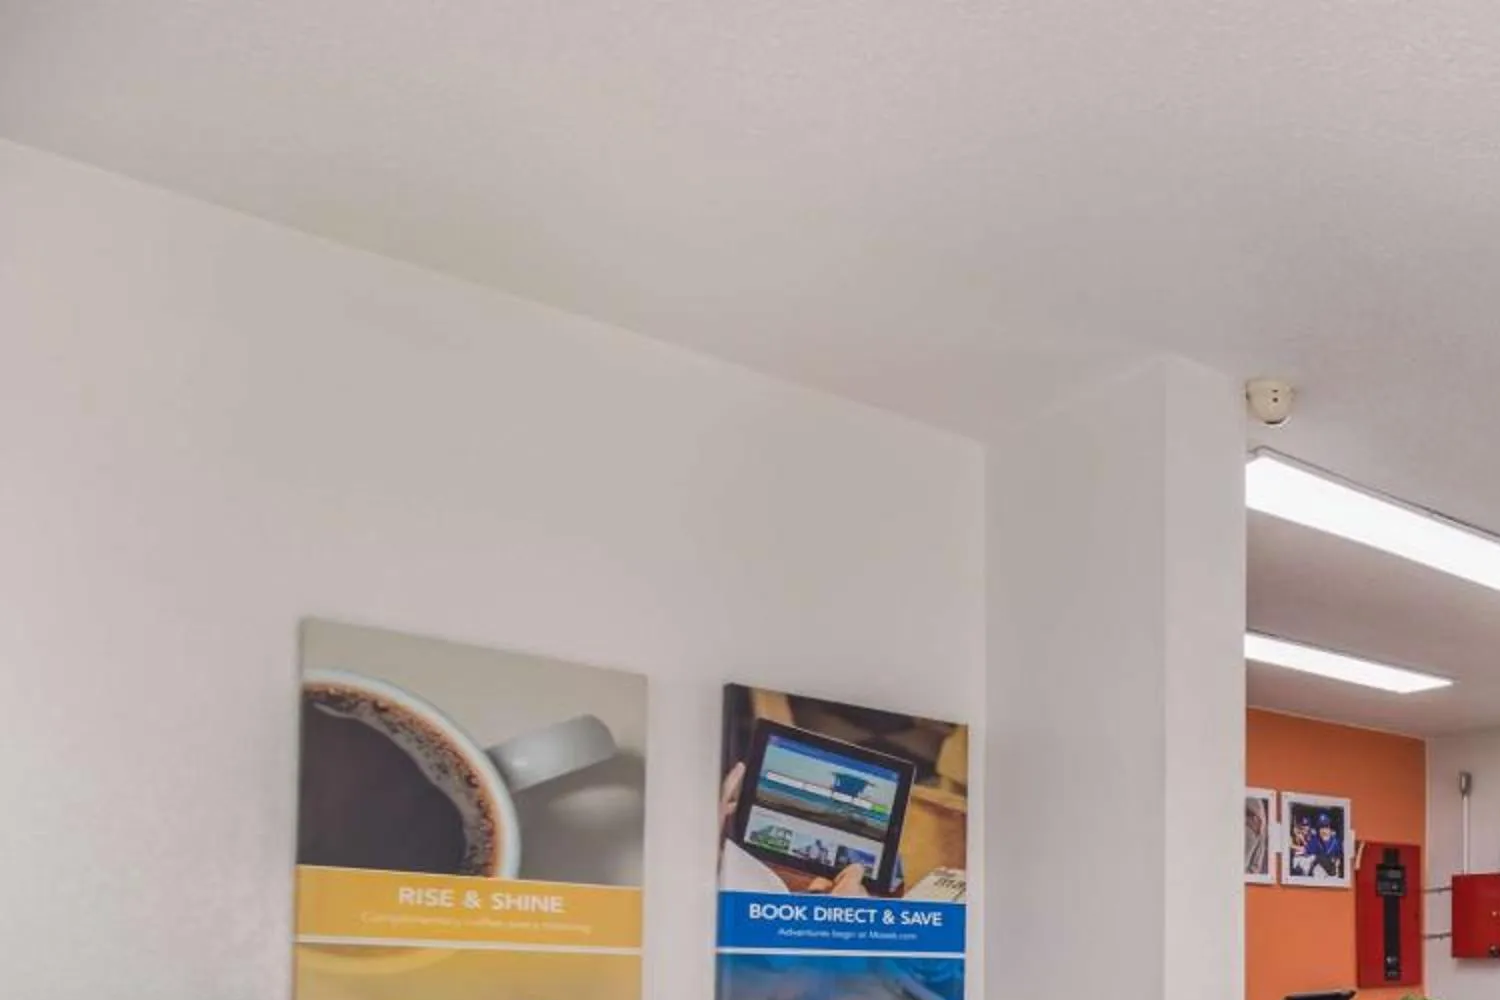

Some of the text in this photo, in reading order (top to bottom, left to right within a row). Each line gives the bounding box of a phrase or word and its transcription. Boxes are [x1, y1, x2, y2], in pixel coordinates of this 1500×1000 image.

[399, 886, 566, 914] RISE & SHINE
[749, 903, 944, 927] BOOK DIRECT & SAVE
